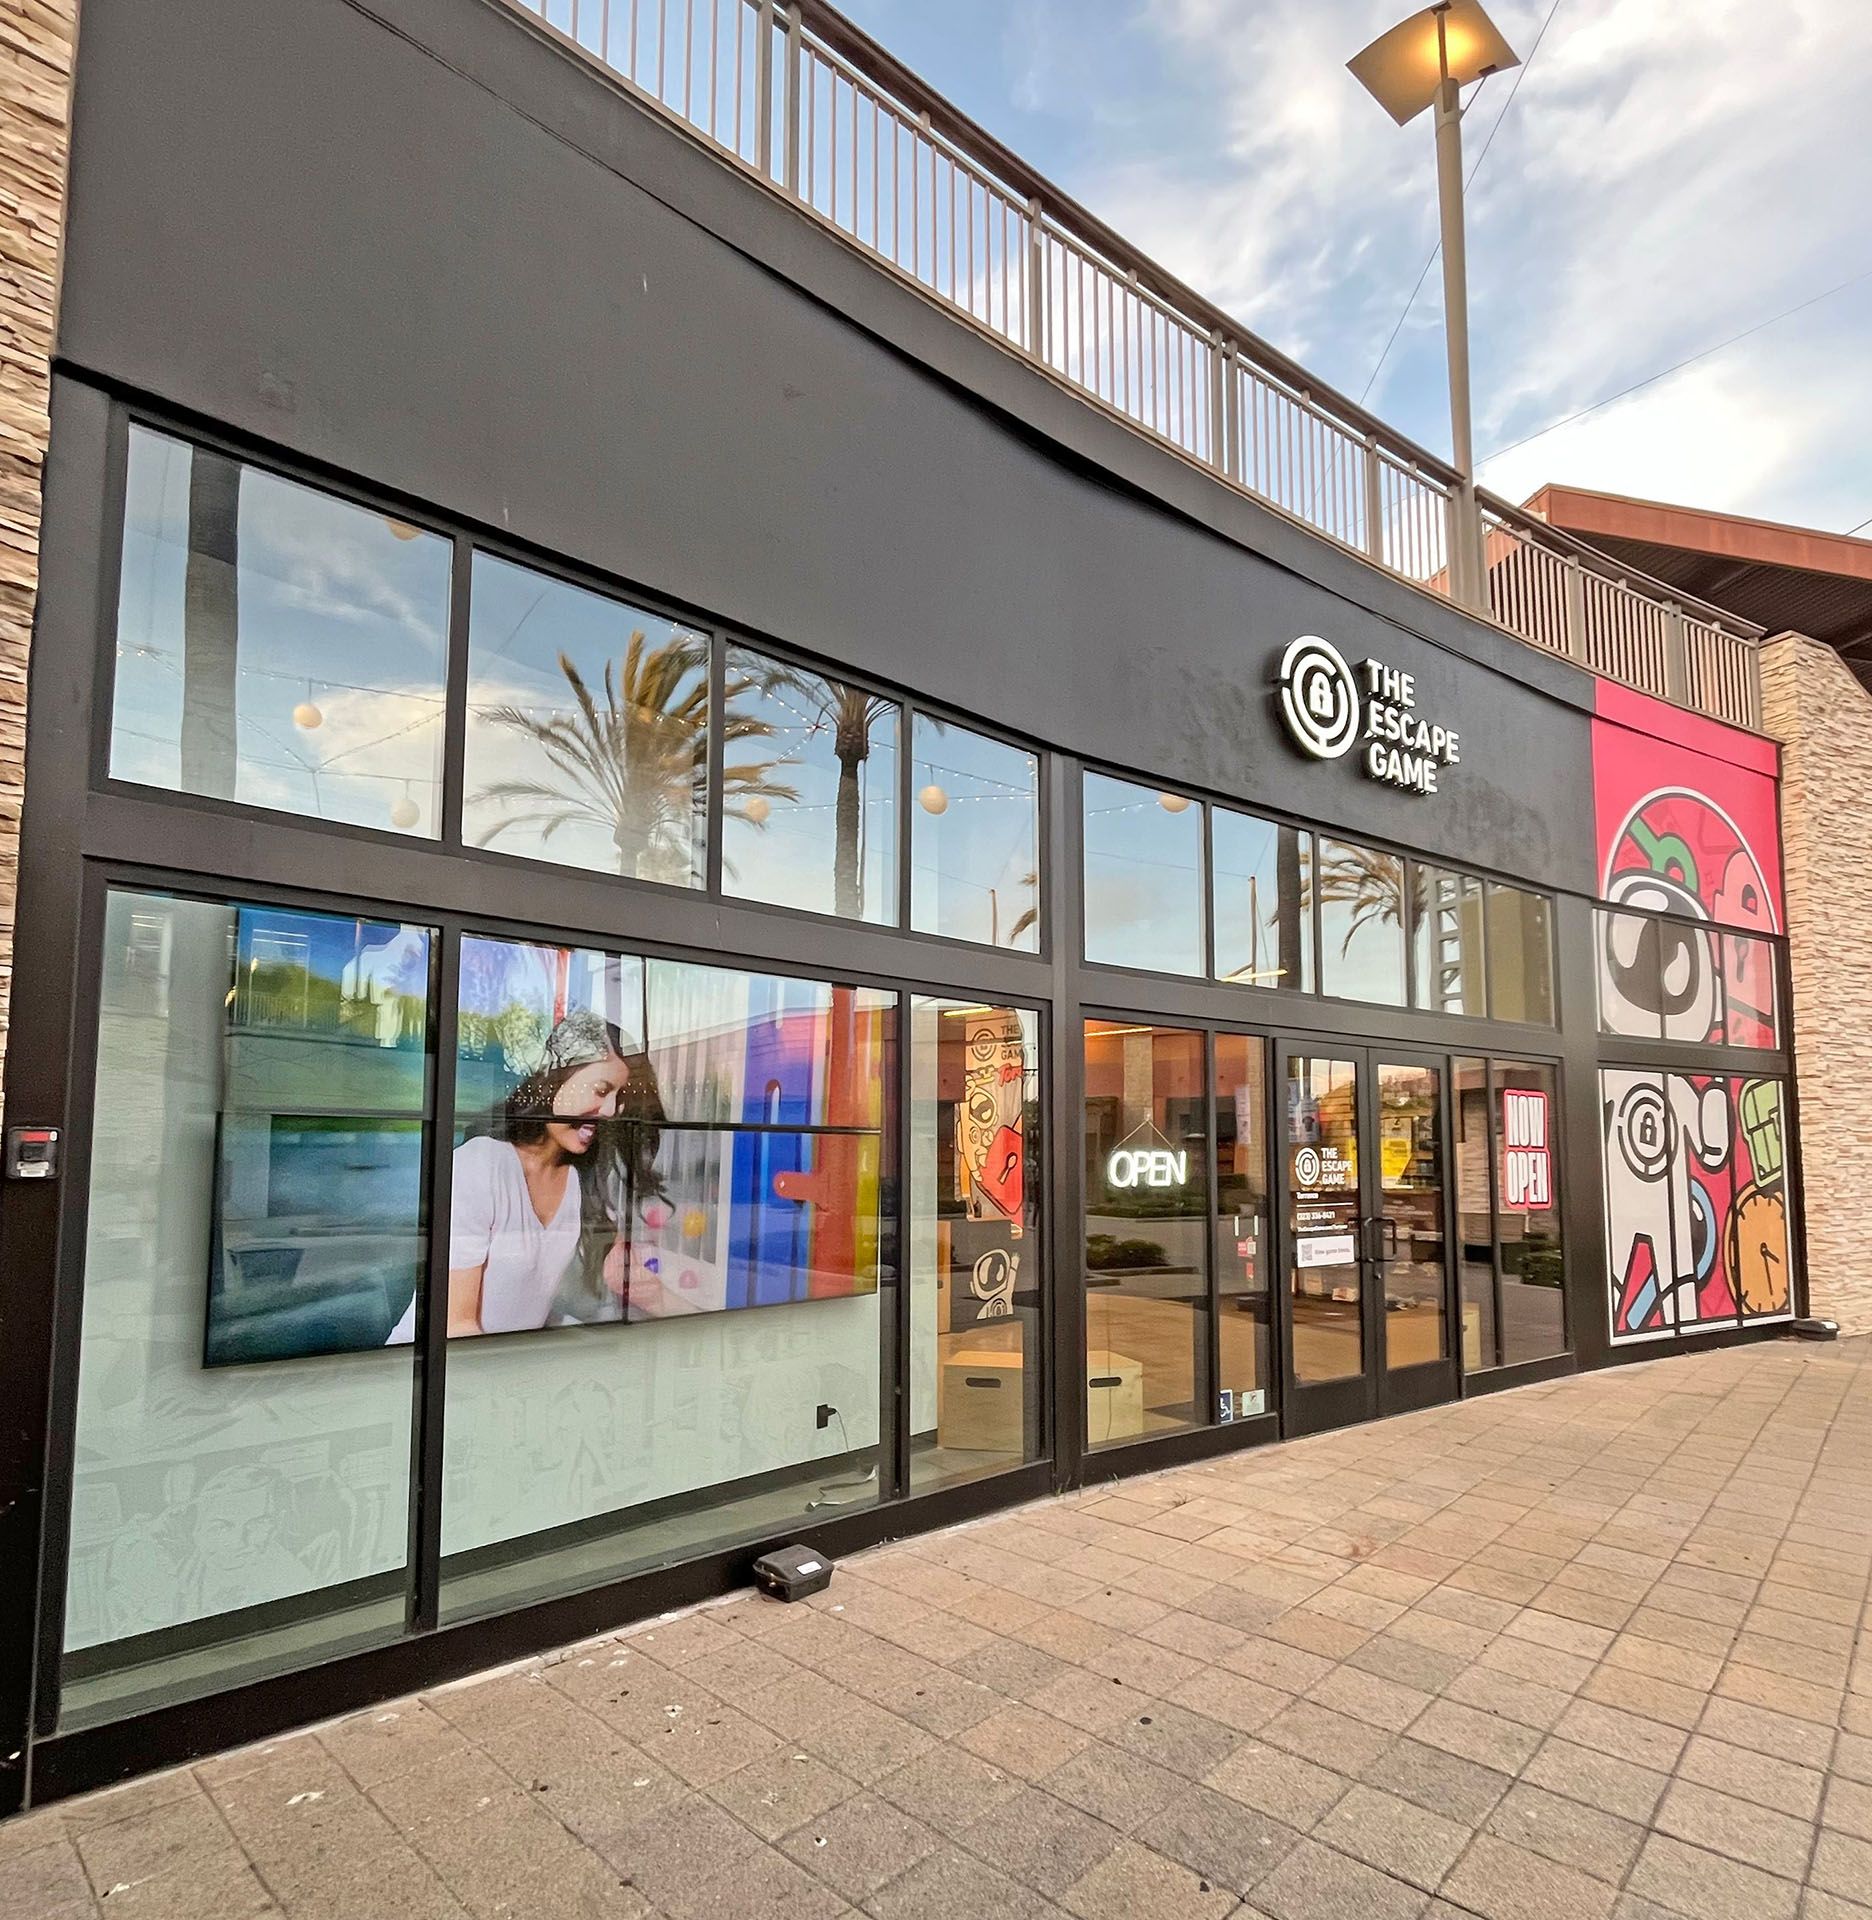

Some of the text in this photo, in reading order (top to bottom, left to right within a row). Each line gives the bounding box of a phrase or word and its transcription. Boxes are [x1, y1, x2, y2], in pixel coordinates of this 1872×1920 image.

[1366, 658, 1416, 708] THE
[1369, 700, 1461, 763] ESCAPE
[1368, 742, 1438, 793] GAME
[1001, 1024, 1020, 1035] THE
[1001, 1048, 1022, 1060] GAM
[1506, 1094, 1545, 1147] NOW
[1108, 1150, 1187, 1188] OPEN
[1320, 1147, 1338, 1159] THE
[1321, 1160, 1353, 1172] ESCAPE
[1322, 1173, 1345, 1185] GAME
[1506, 1151, 1549, 1204] OPEN
